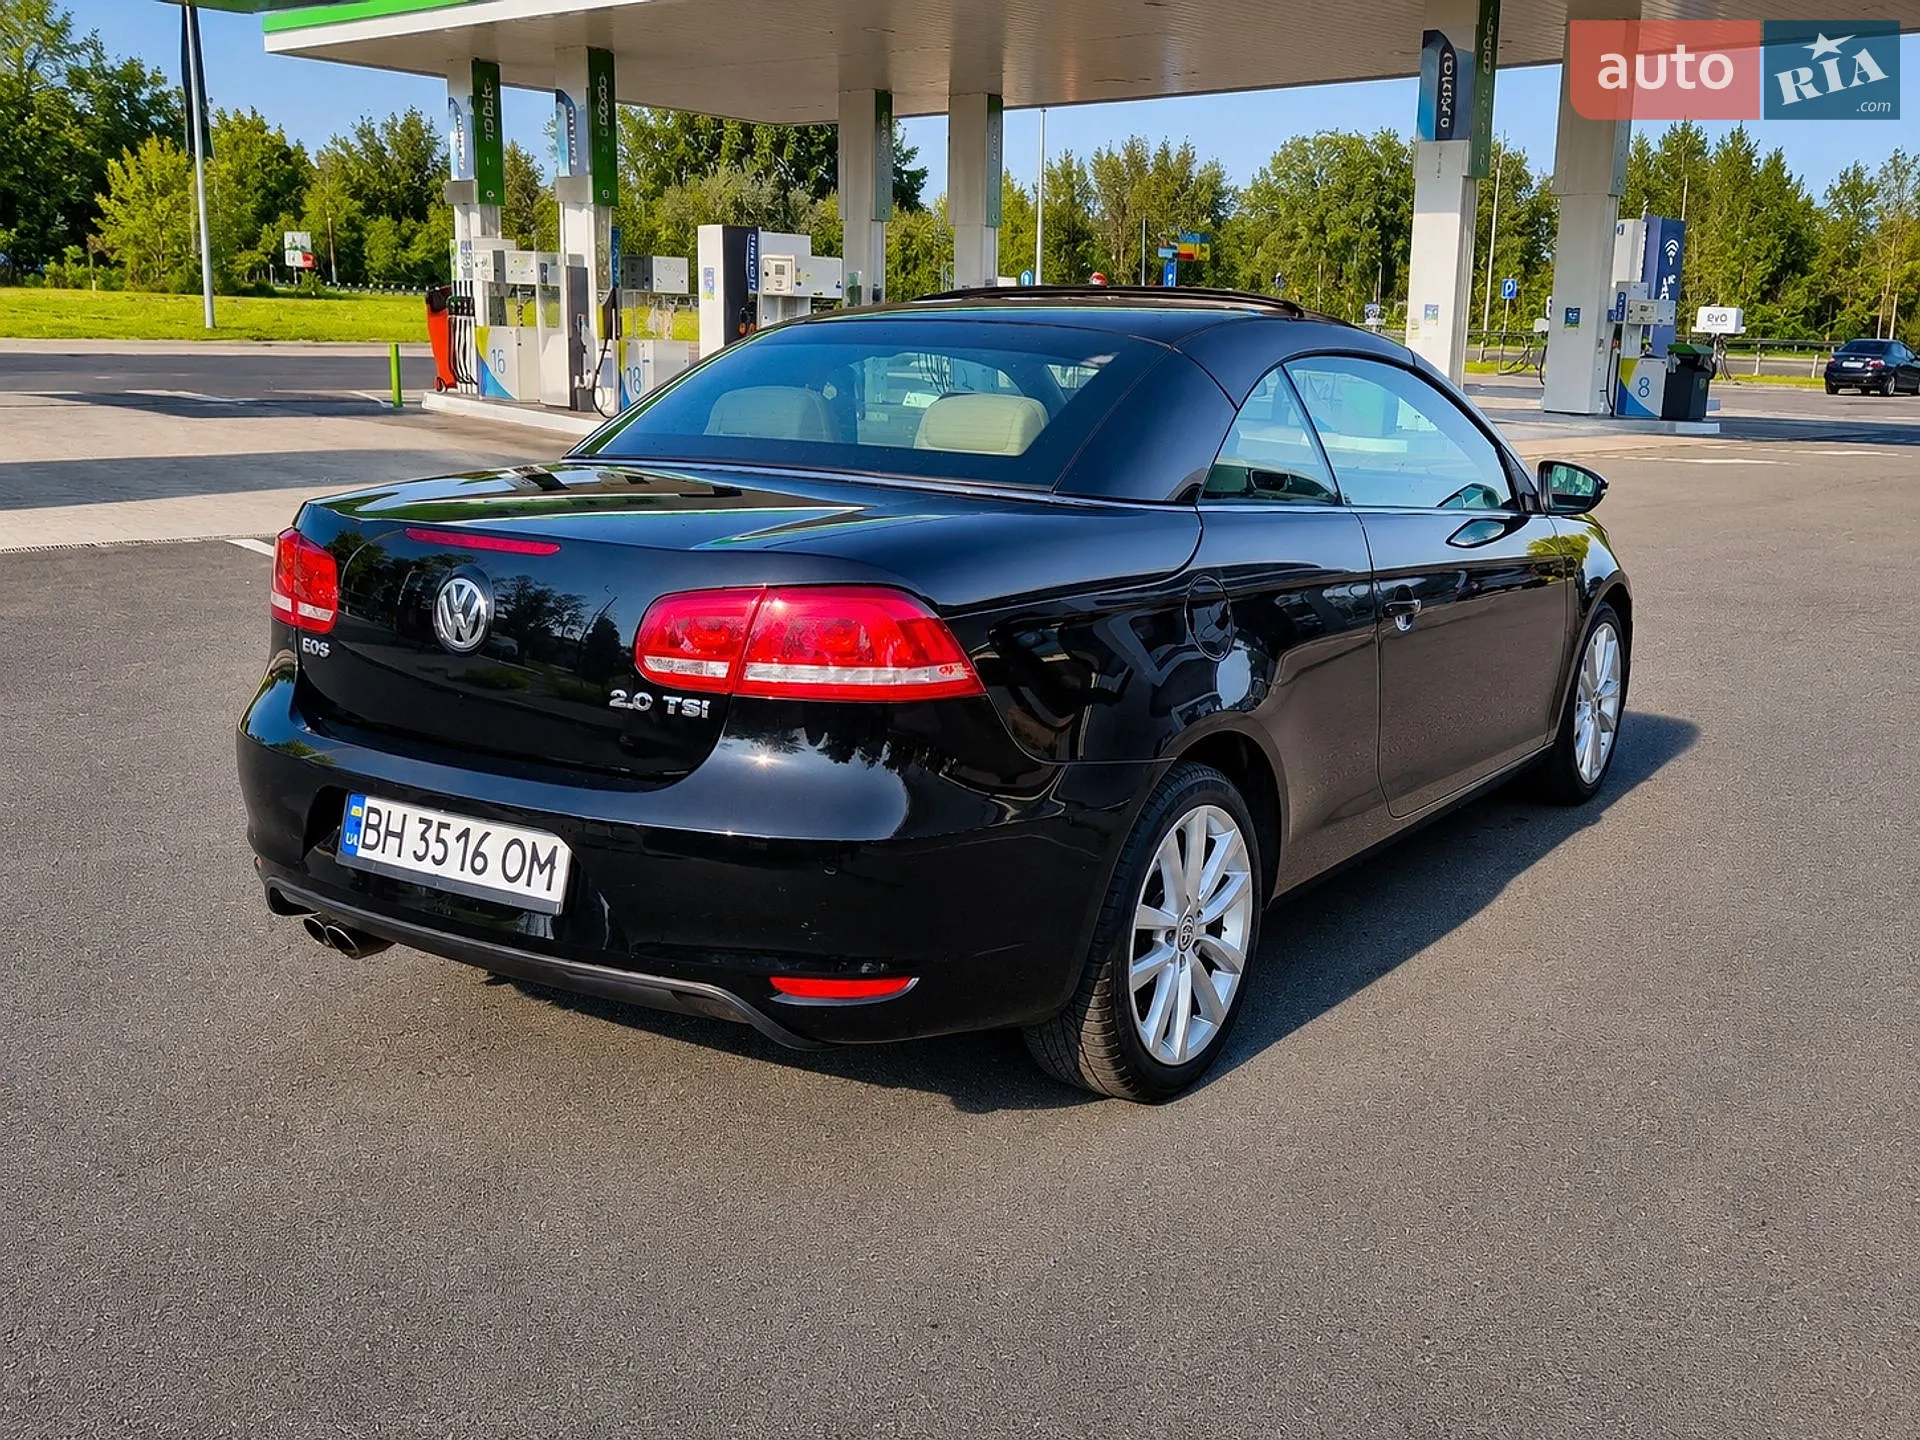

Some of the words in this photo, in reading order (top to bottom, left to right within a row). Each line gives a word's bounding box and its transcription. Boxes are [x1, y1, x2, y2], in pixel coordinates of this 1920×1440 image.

[491, 348, 506, 375] 16
[626, 365, 642, 395] 18
[1638, 376, 1650, 398] 8
[302, 637, 331, 658] EOS
[608, 689, 654, 712] 2.0
[361, 806, 408, 858] BH
[413, 816, 492, 876] 3516
[502, 838, 558, 892] OM
